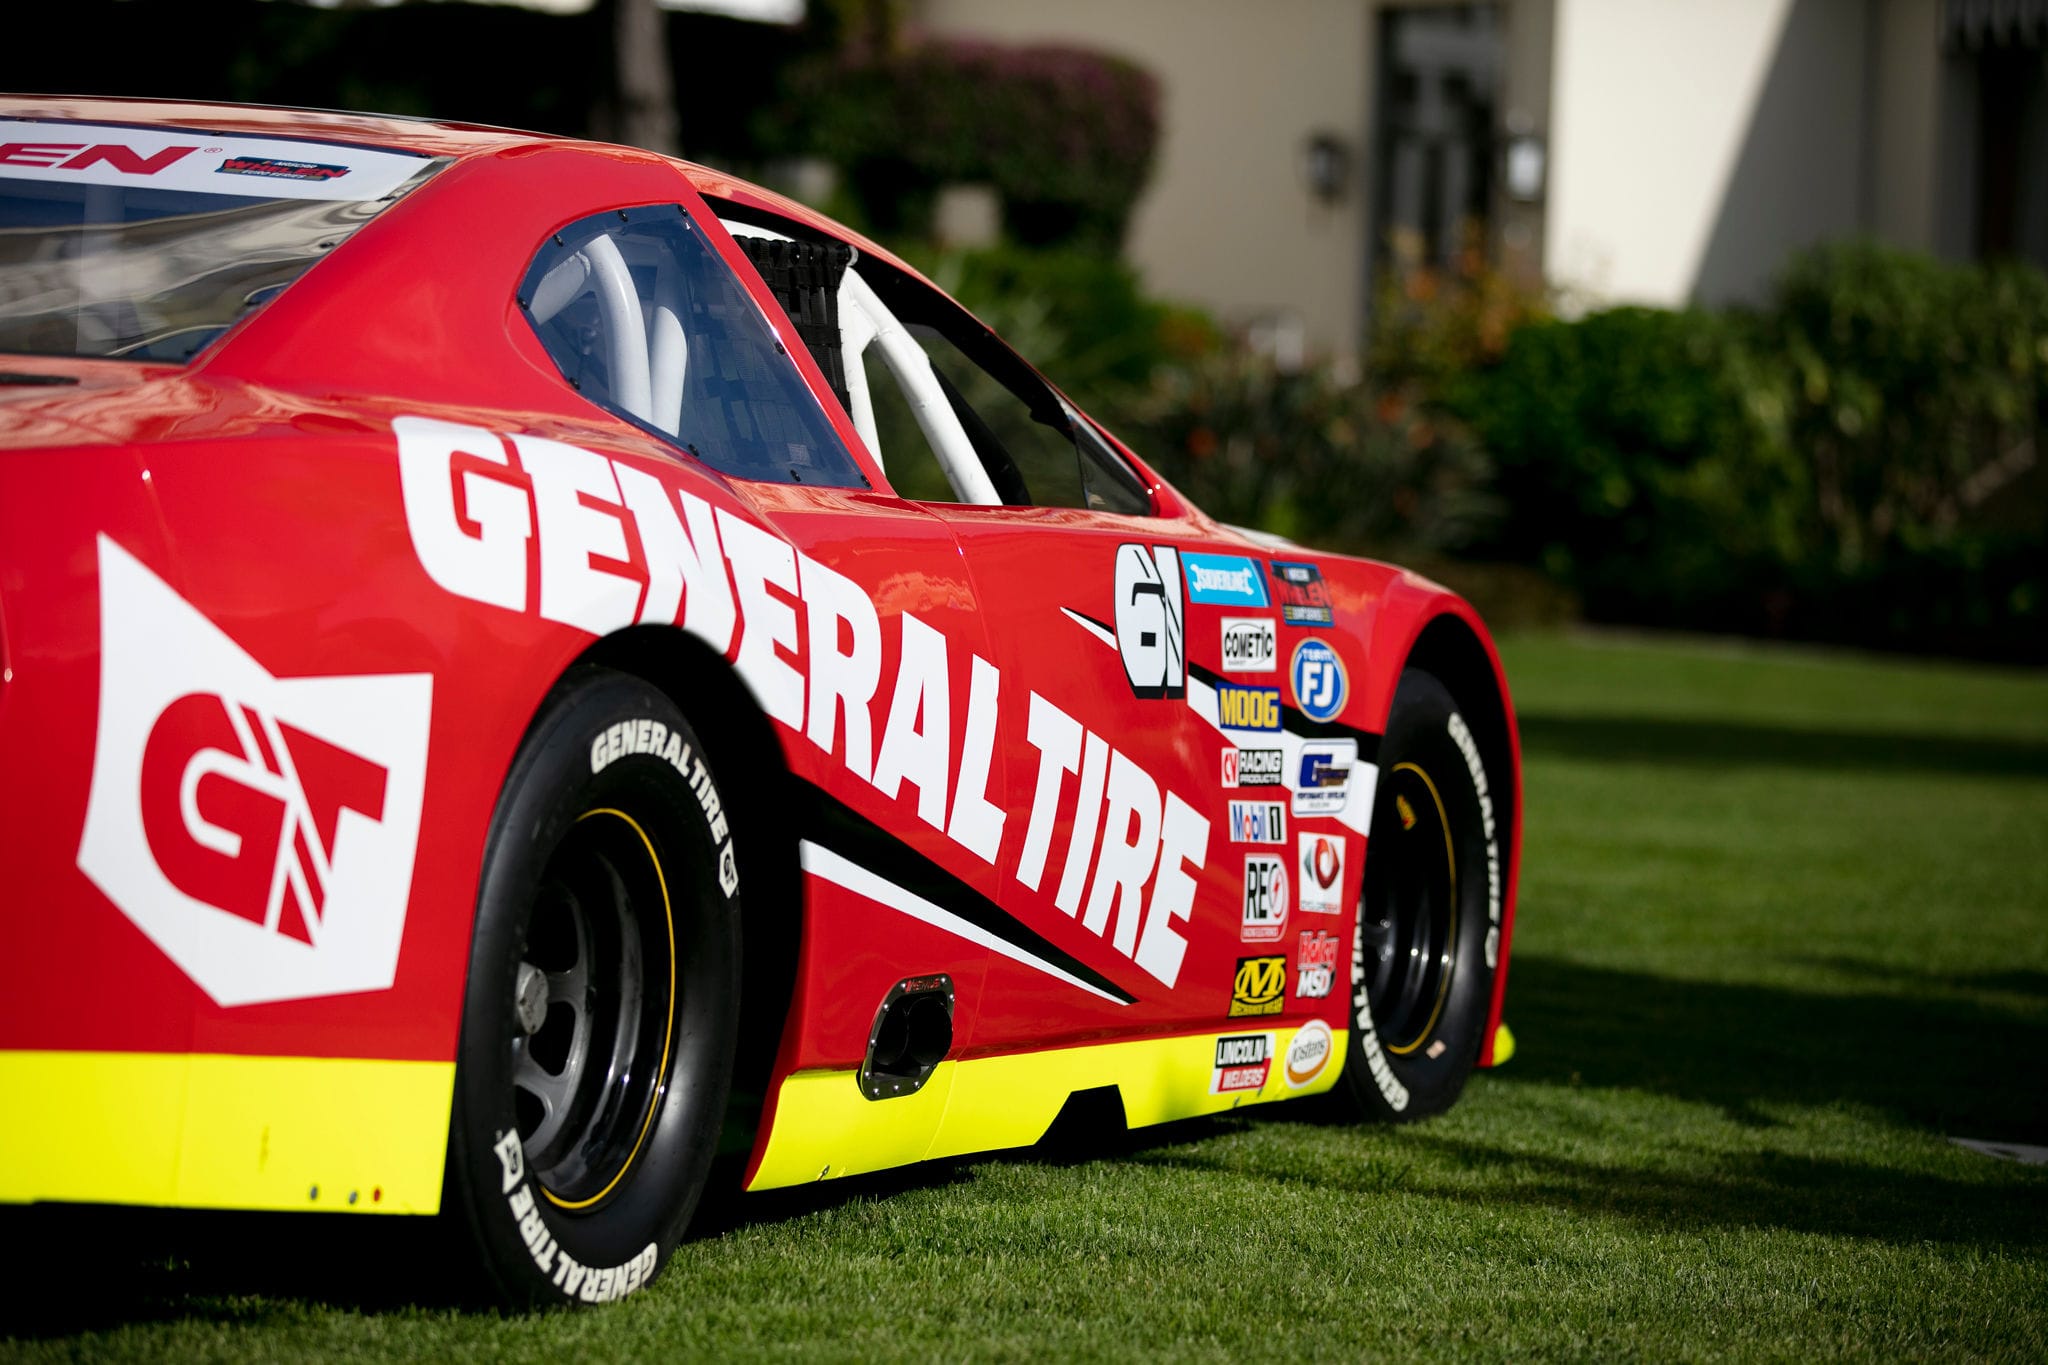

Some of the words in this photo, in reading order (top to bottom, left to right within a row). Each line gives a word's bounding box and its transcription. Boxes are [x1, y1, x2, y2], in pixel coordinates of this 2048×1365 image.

[1114, 543, 1185, 699] 61
[1224, 625, 1273, 658] COMETIC
[393, 417, 1006, 865] GENERAL
[1015, 689, 1211, 989] TIRE
[1301, 661, 1335, 707] FJ
[1220, 688, 1279, 728] MOOG
[1240, 751, 1281, 772] RACING
[1240, 774, 1280, 784] PRODUCTS
[591, 719, 694, 778] GENERAL
[688, 757, 729, 845] TIRE
[1233, 804, 1266, 841] Mobil
[1296, 970, 1332, 998] MSD
[1217, 1038, 1265, 1065] LINCOLN
[1222, 1068, 1265, 1089] WELDERS
[509, 1183, 558, 1274] TIRE
[553, 1242, 658, 1302] GENERAL
